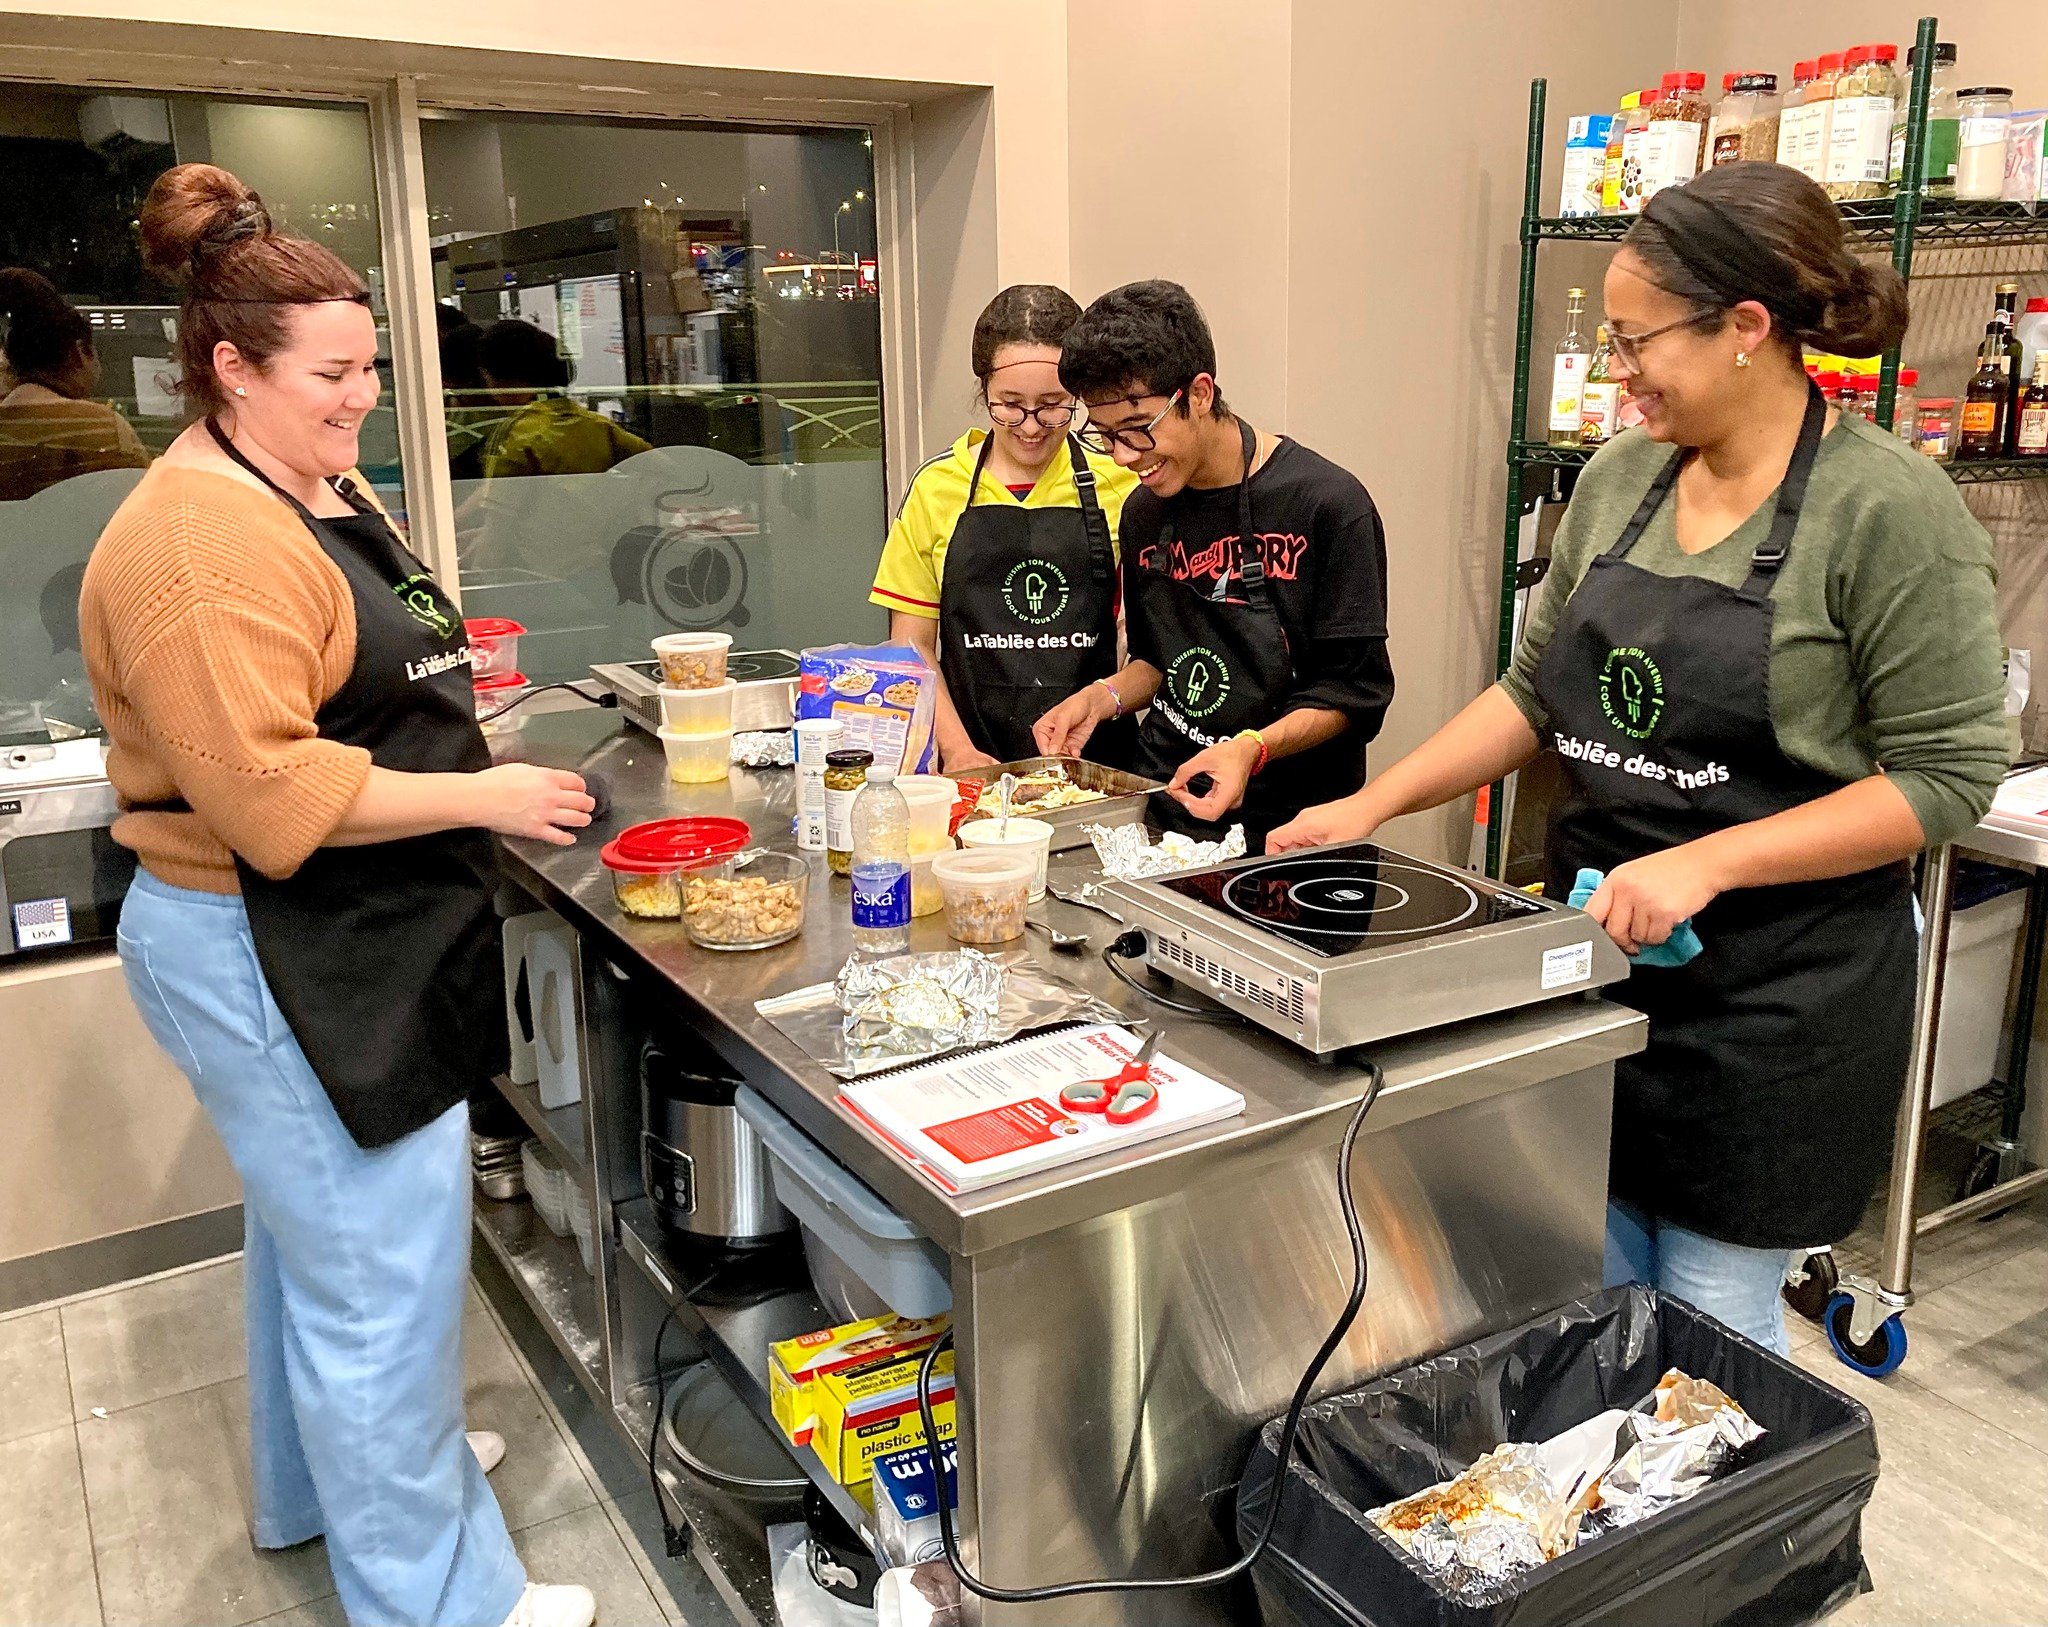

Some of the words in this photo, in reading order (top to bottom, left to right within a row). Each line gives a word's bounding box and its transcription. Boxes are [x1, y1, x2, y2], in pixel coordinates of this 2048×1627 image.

[1004, 561, 1027, 587] CUISINE
[1028, 559, 1044, 567] TON
[1045, 562, 1067, 585] AVENIR
[1139, 541, 1190, 581] TM
[1004, 594, 1018, 616] COOK
[1018, 614, 1029, 622] UP
[1030, 616, 1051, 625] YOUR
[1051, 594, 1069, 620] FUTURE
[1037, 634, 1067, 648] des
[1172, 647, 1197, 668] CUISIN
[1197, 647, 1211, 657] TON
[1211, 654, 1230, 682] AVENIR
[1643, 657, 1663, 694] AVENIR
[1185, 707, 1203, 718] YOUR
[1203, 691, 1228, 716] FUTURE
[1600, 685, 1615, 717] COOK
[1611, 716, 1625, 730] UP
[1189, 726, 1214, 747] des
[1623, 754, 1667, 781] des
[853, 890, 893, 907] eska
[32, 929, 57, 940] USA
[844, 1374, 879, 1389] plastic
[880, 1366, 907, 1378] wrap
[849, 1378, 891, 1396] pellicule
[861, 1428, 871, 1436] no
[861, 1433, 912, 1459] plastic
[914, 1422, 953, 1441] wap
[891, 1460, 924, 1480] m
[897, 1453, 910, 1462] 60
